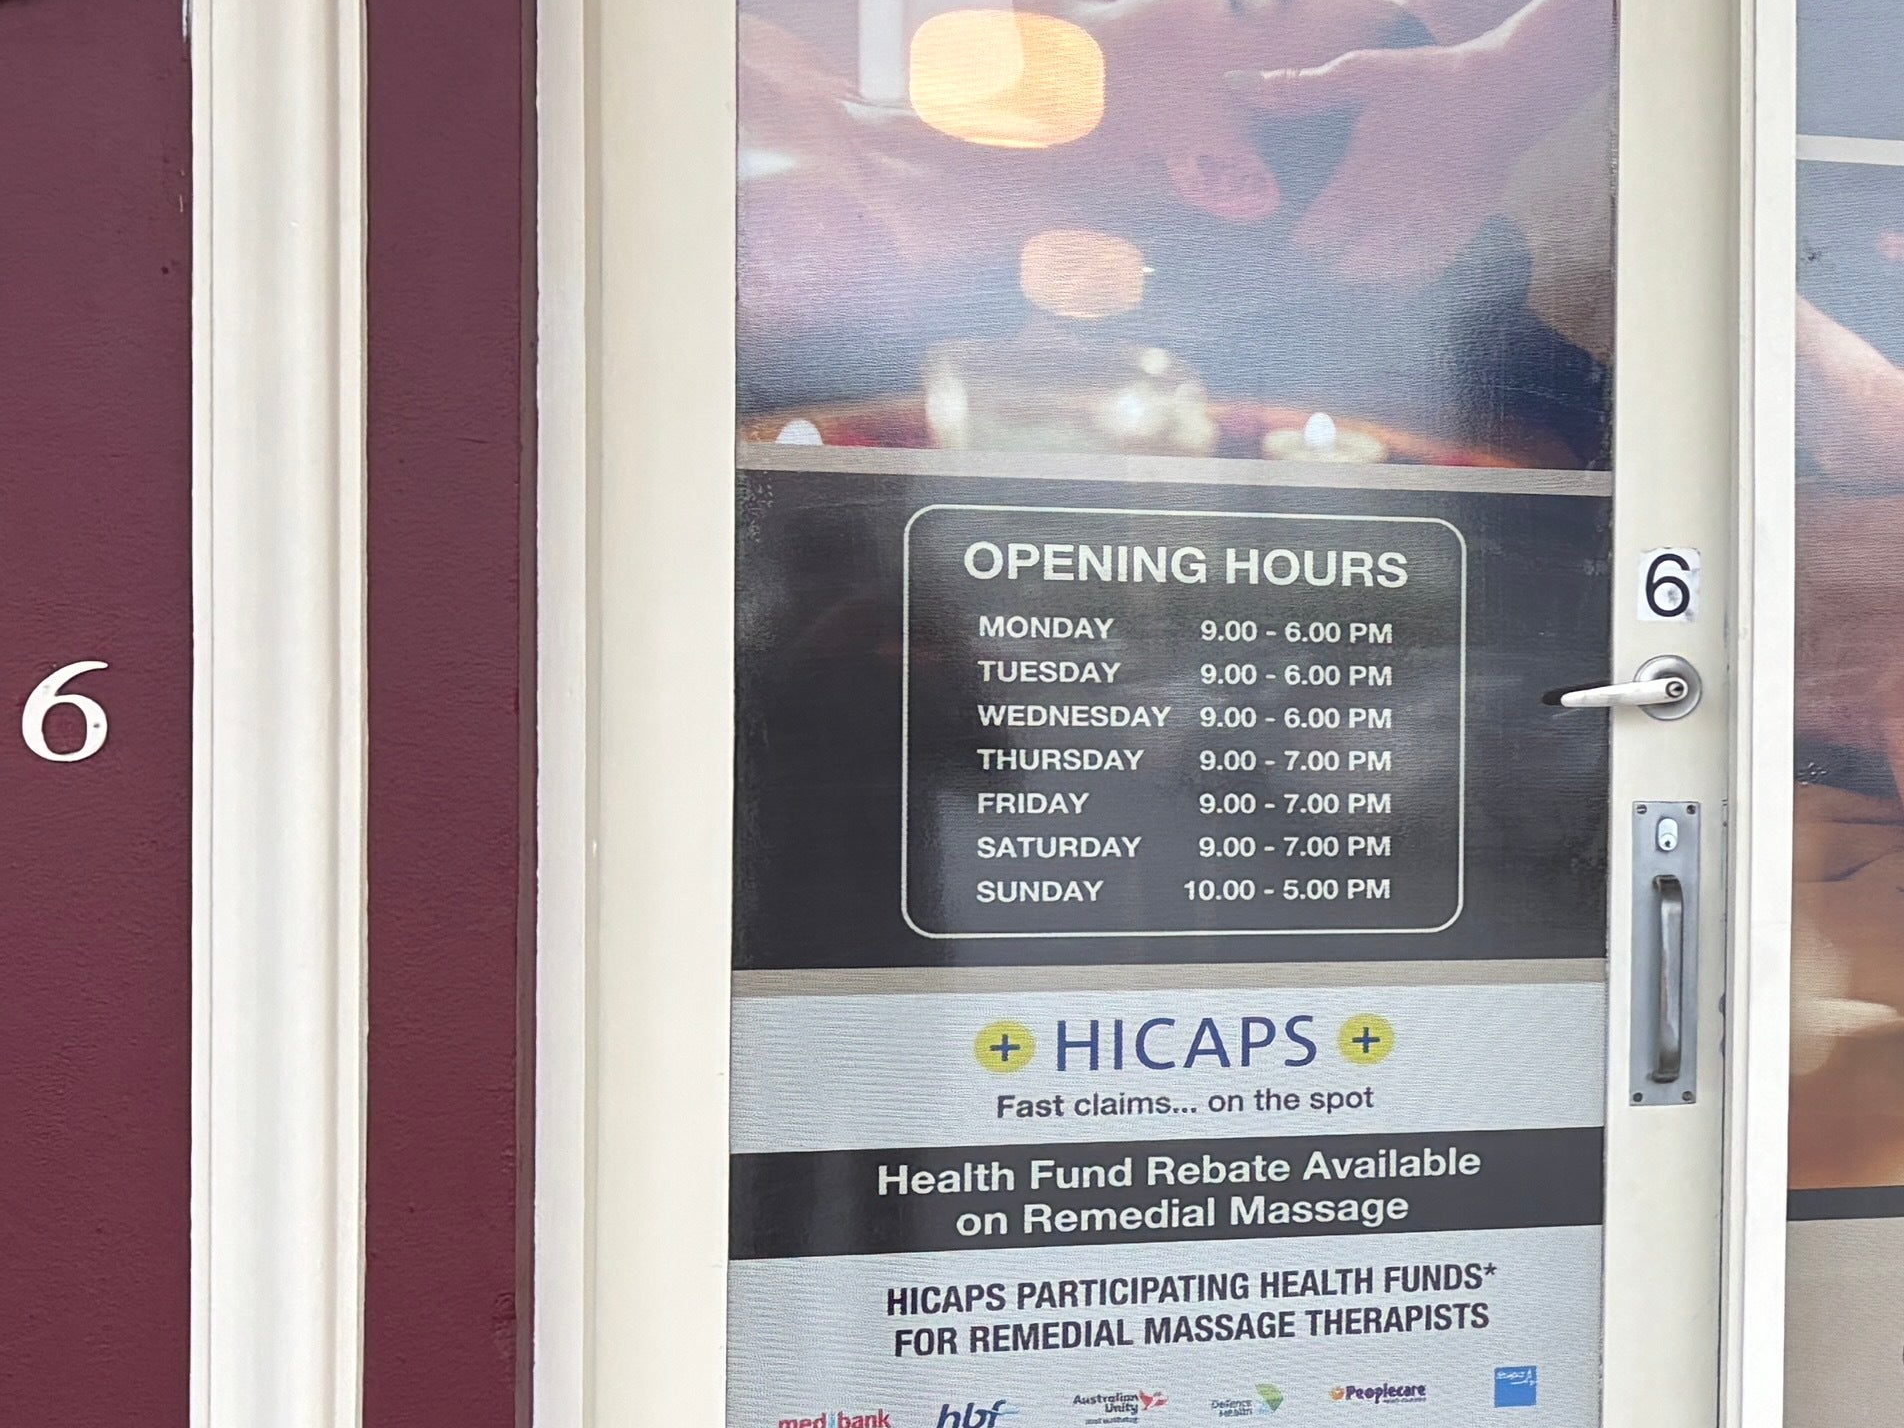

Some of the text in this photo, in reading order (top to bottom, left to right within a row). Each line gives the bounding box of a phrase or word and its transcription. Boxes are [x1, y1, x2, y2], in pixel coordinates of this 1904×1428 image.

[964, 541, 1408, 587] OPENING HOURS
[1646, 554, 1690, 617] 6
[980, 616, 1113, 639] MONDAY
[1201, 620, 1257, 641] 9.00
[1285, 622, 1340, 642] 6.00
[1350, 623, 1392, 643] PM
[22, 661, 108, 761] 6
[977, 881, 1103, 902] SUNDAY
[1184, 880, 1255, 900] 10.00
[1283, 880, 1338, 900] 5.00
[1348, 879, 1390, 899] PM
[1057, 1015, 1316, 1071] HICAPS
[998, 1087, 1373, 1118] Fast claims... on the spot
[879, 1148, 1480, 1195] Health Fund Rebate Available
[957, 1196, 1408, 1235] on Remedial Massage
[887, 1284, 1005, 1316] HICAPS
[1018, 1273, 1248, 1309] PARTICIPATING
[1261, 1267, 1372, 1298] HEALTH
[895, 1303, 1489, 1357] FOR REMEDIAL MASSAGE THERAPISTS
